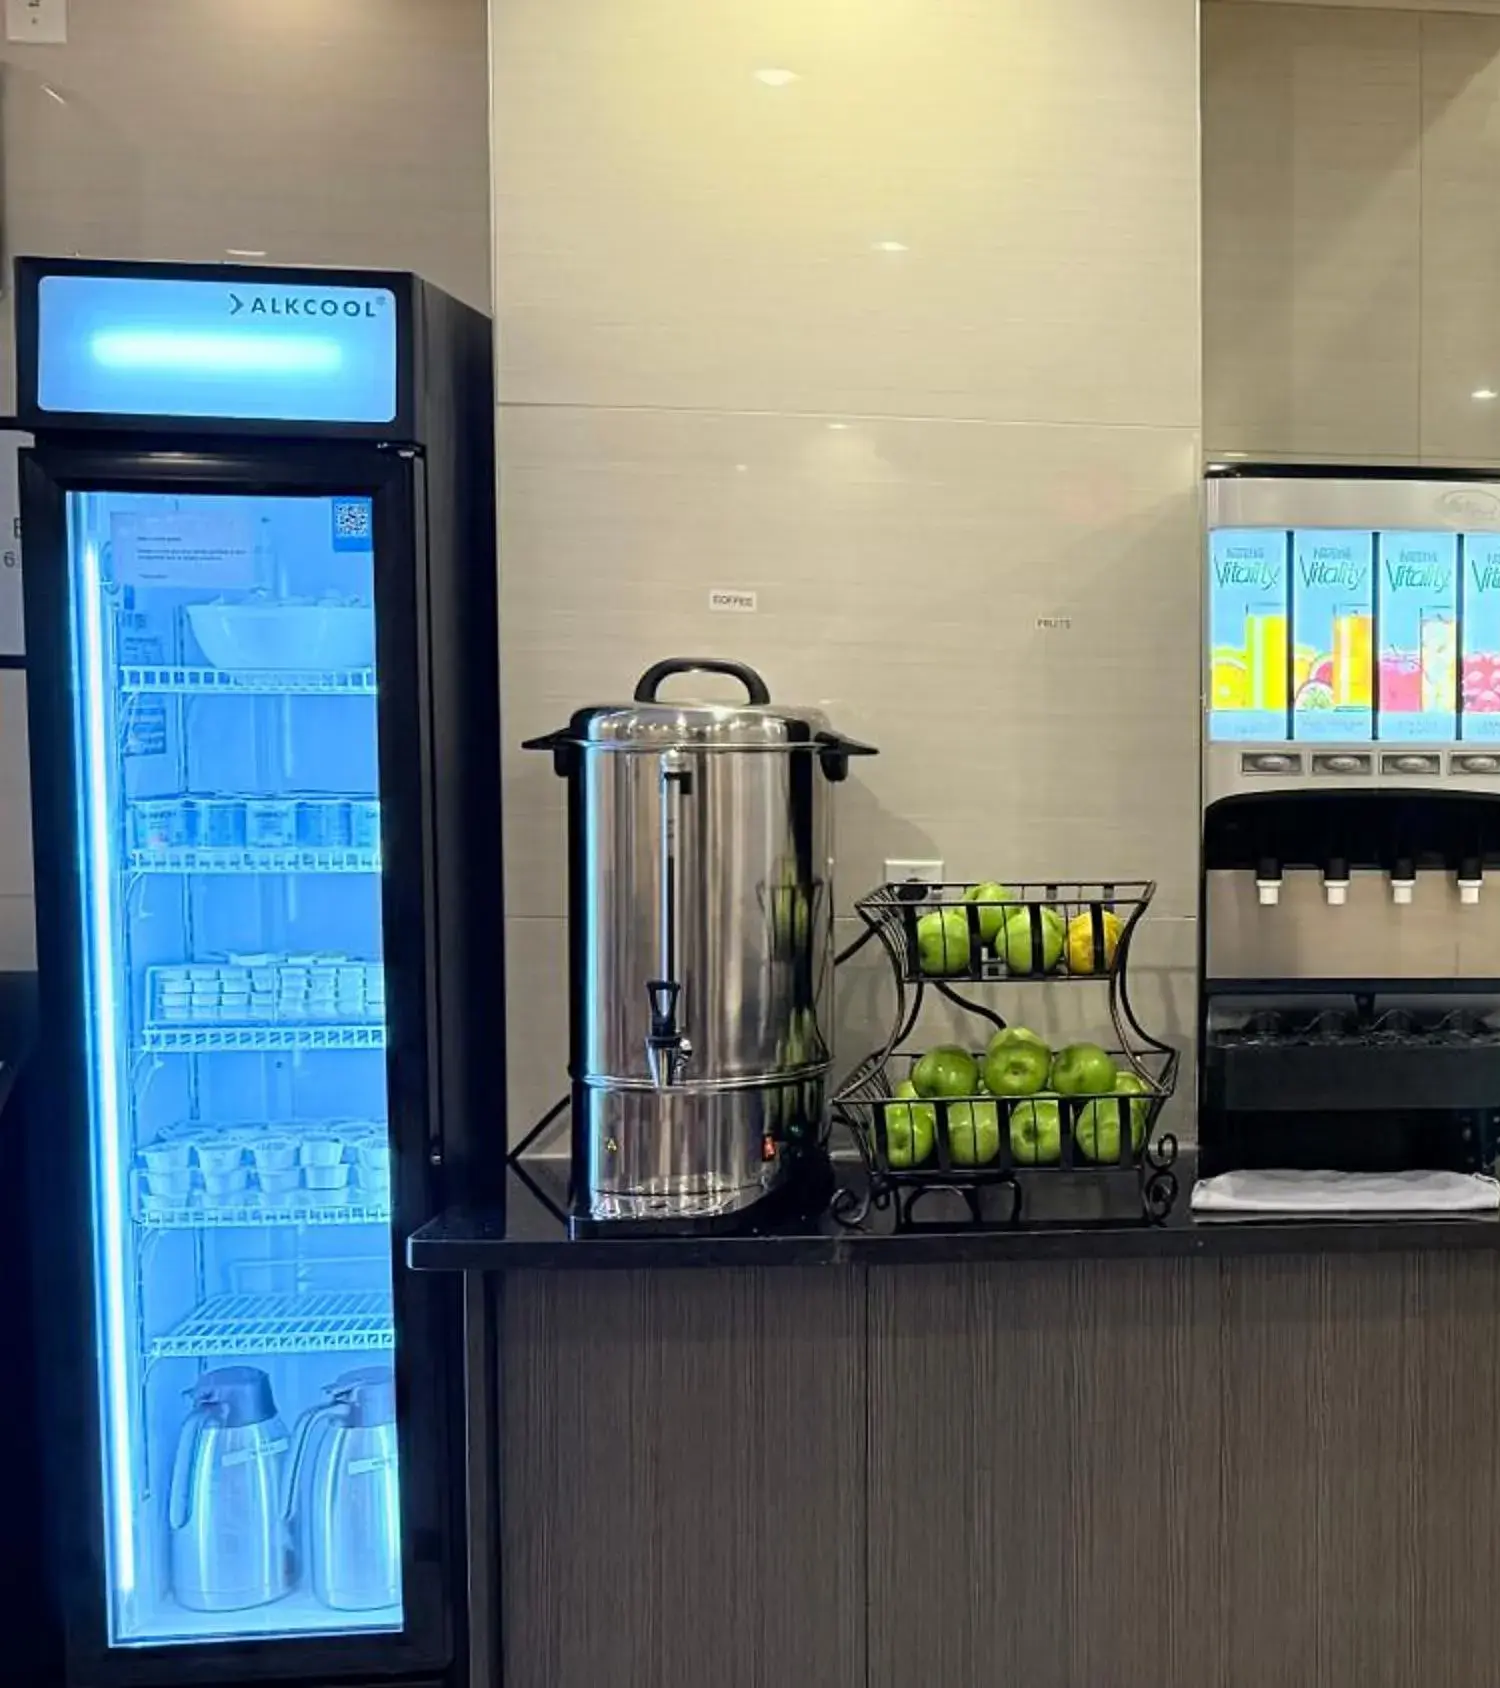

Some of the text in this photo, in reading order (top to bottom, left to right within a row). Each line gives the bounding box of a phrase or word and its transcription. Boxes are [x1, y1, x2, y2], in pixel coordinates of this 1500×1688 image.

[251, 297, 376, 317] ALKCOOL
[1213, 554, 1281, 590] Vitality
[1300, 554, 1367, 590] Vitality
[1385, 559, 1452, 594] Vitality
